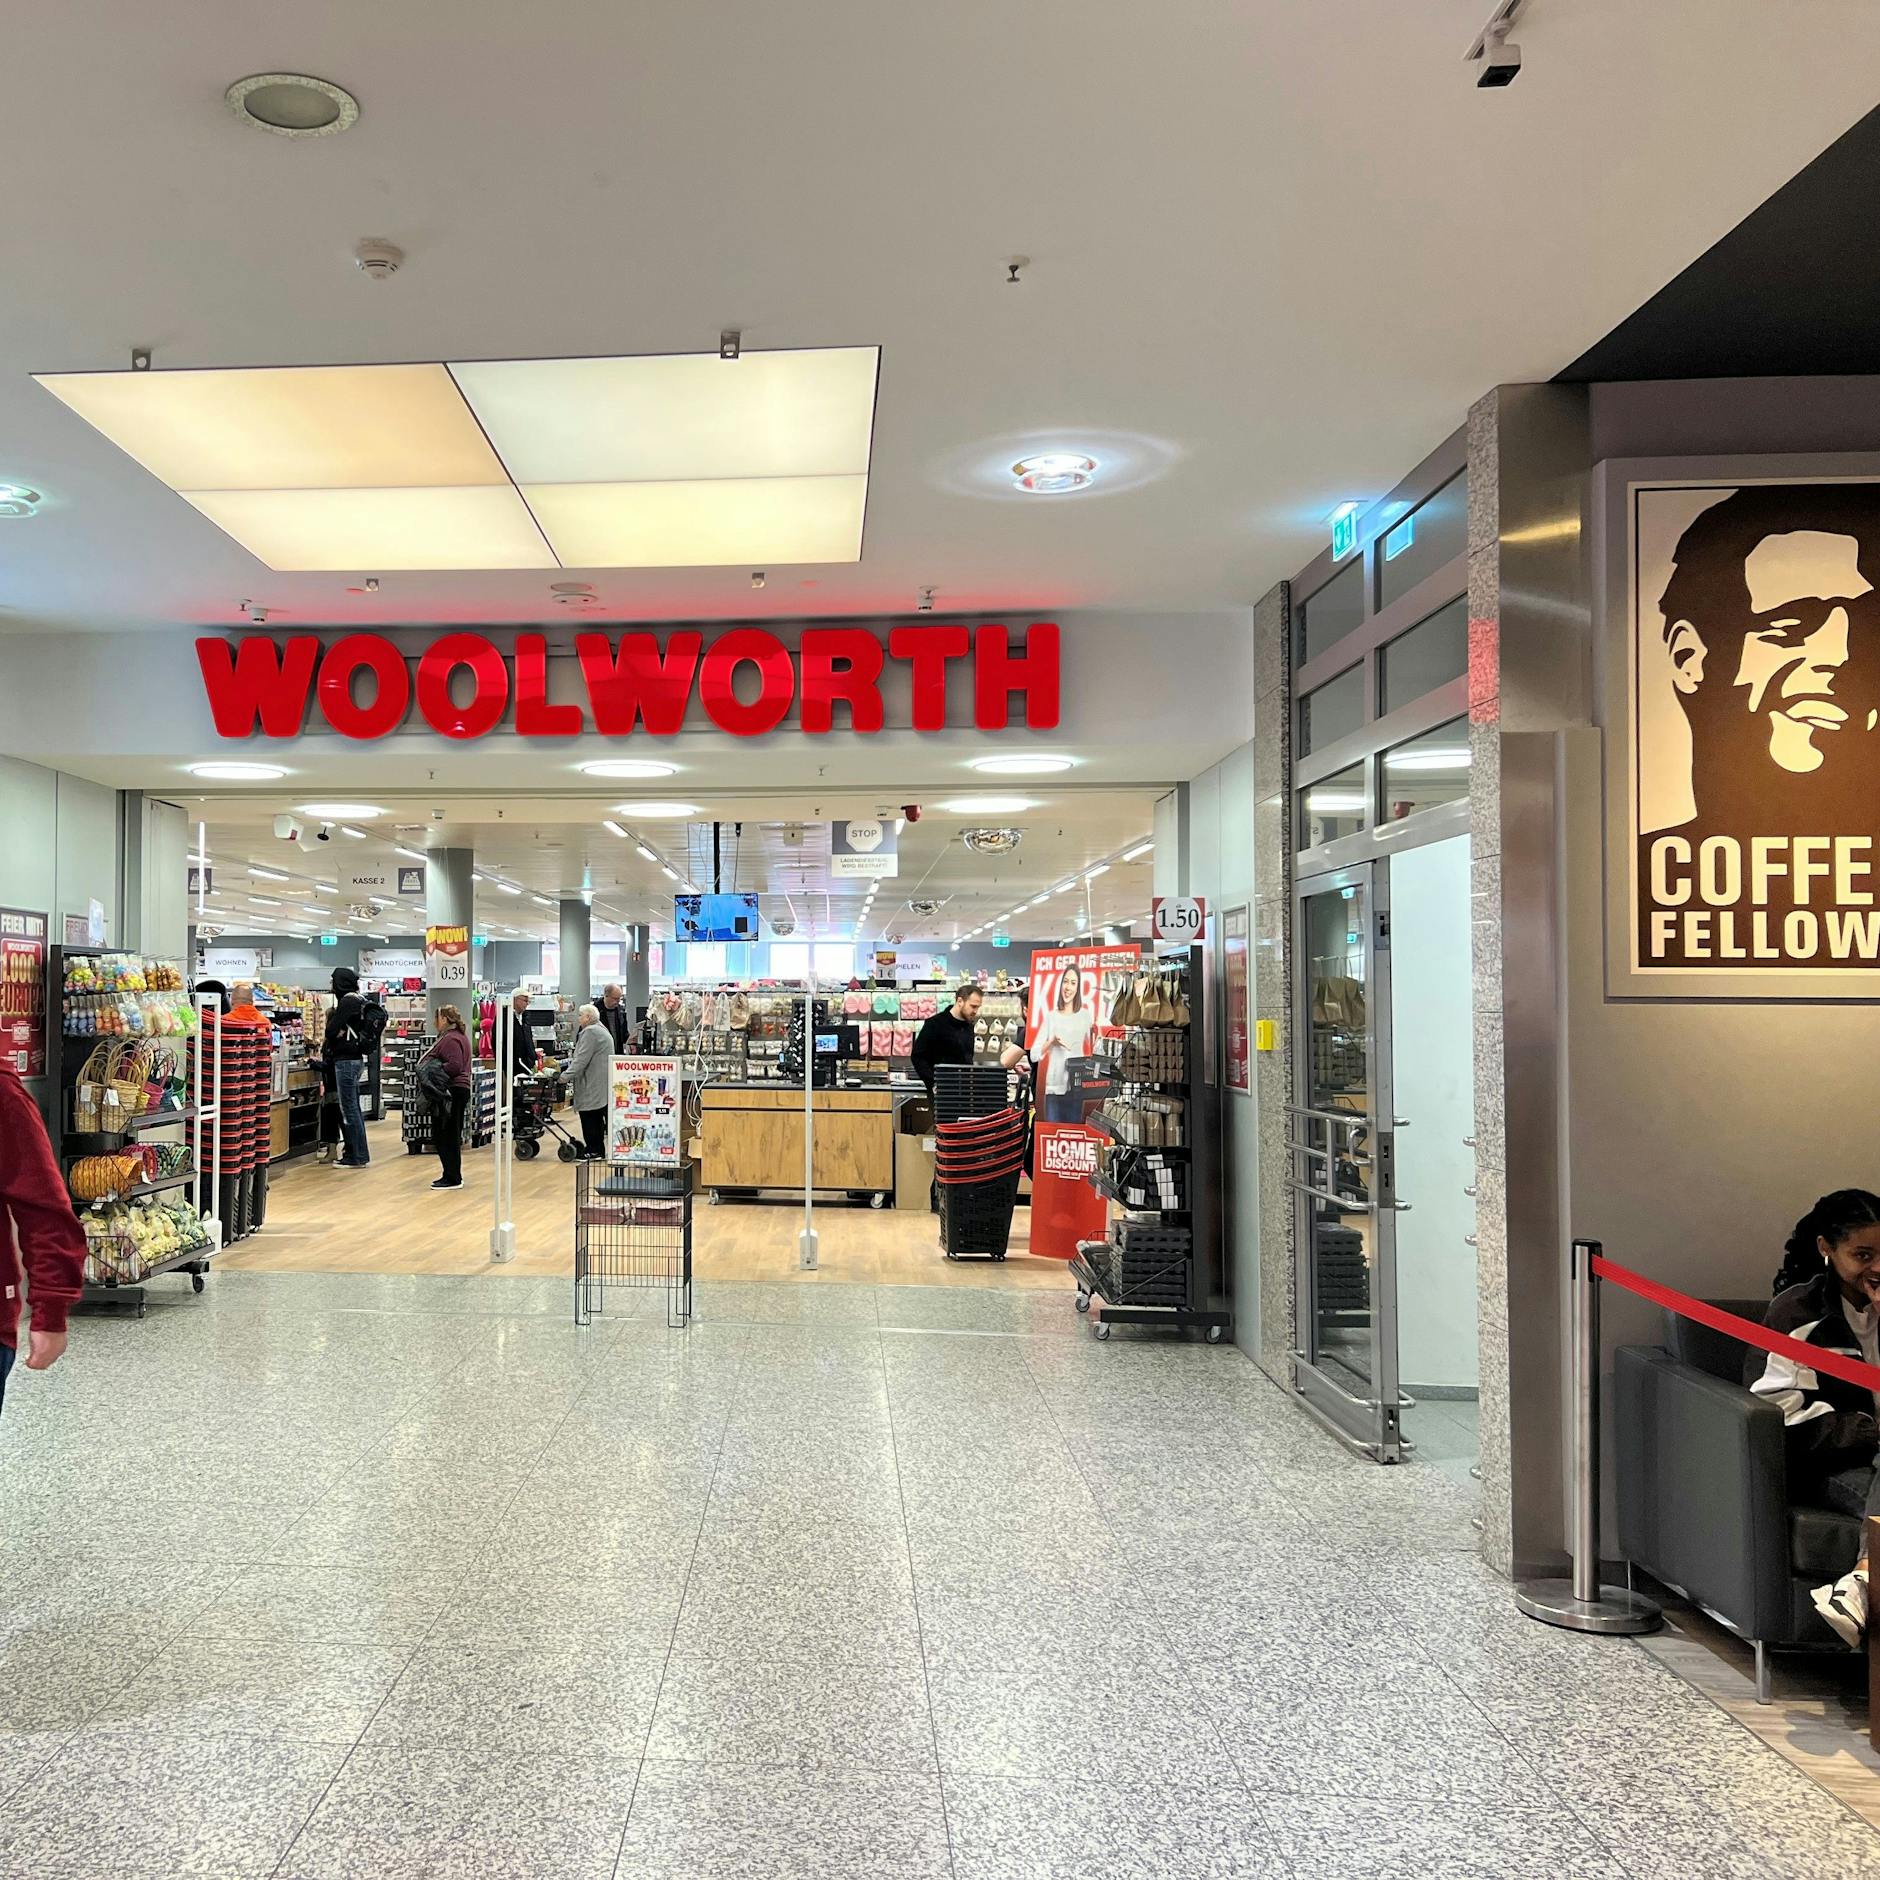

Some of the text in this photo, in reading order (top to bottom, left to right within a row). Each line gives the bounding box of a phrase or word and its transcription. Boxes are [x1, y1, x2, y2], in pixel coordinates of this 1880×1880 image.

[195, 623, 1061, 739] WOOLWORTH
[851, 829, 877, 838] STOP
[1650, 836, 1875, 906] COFFE
[352, 877, 385, 885] KASSE 2
[1158, 908, 1199, 928] 1.50
[1650, 910, 1880, 959] FELLOW
[1036, 956, 1053, 972] ICH
[1078, 953, 1097, 969] DIR
[440, 965, 465, 981] 0.39
[616, 1062, 674, 1072] WOOLWORTH
[1046, 1139, 1097, 1161] HOME
[1045, 1157, 1098, 1173] DISCOUNT
